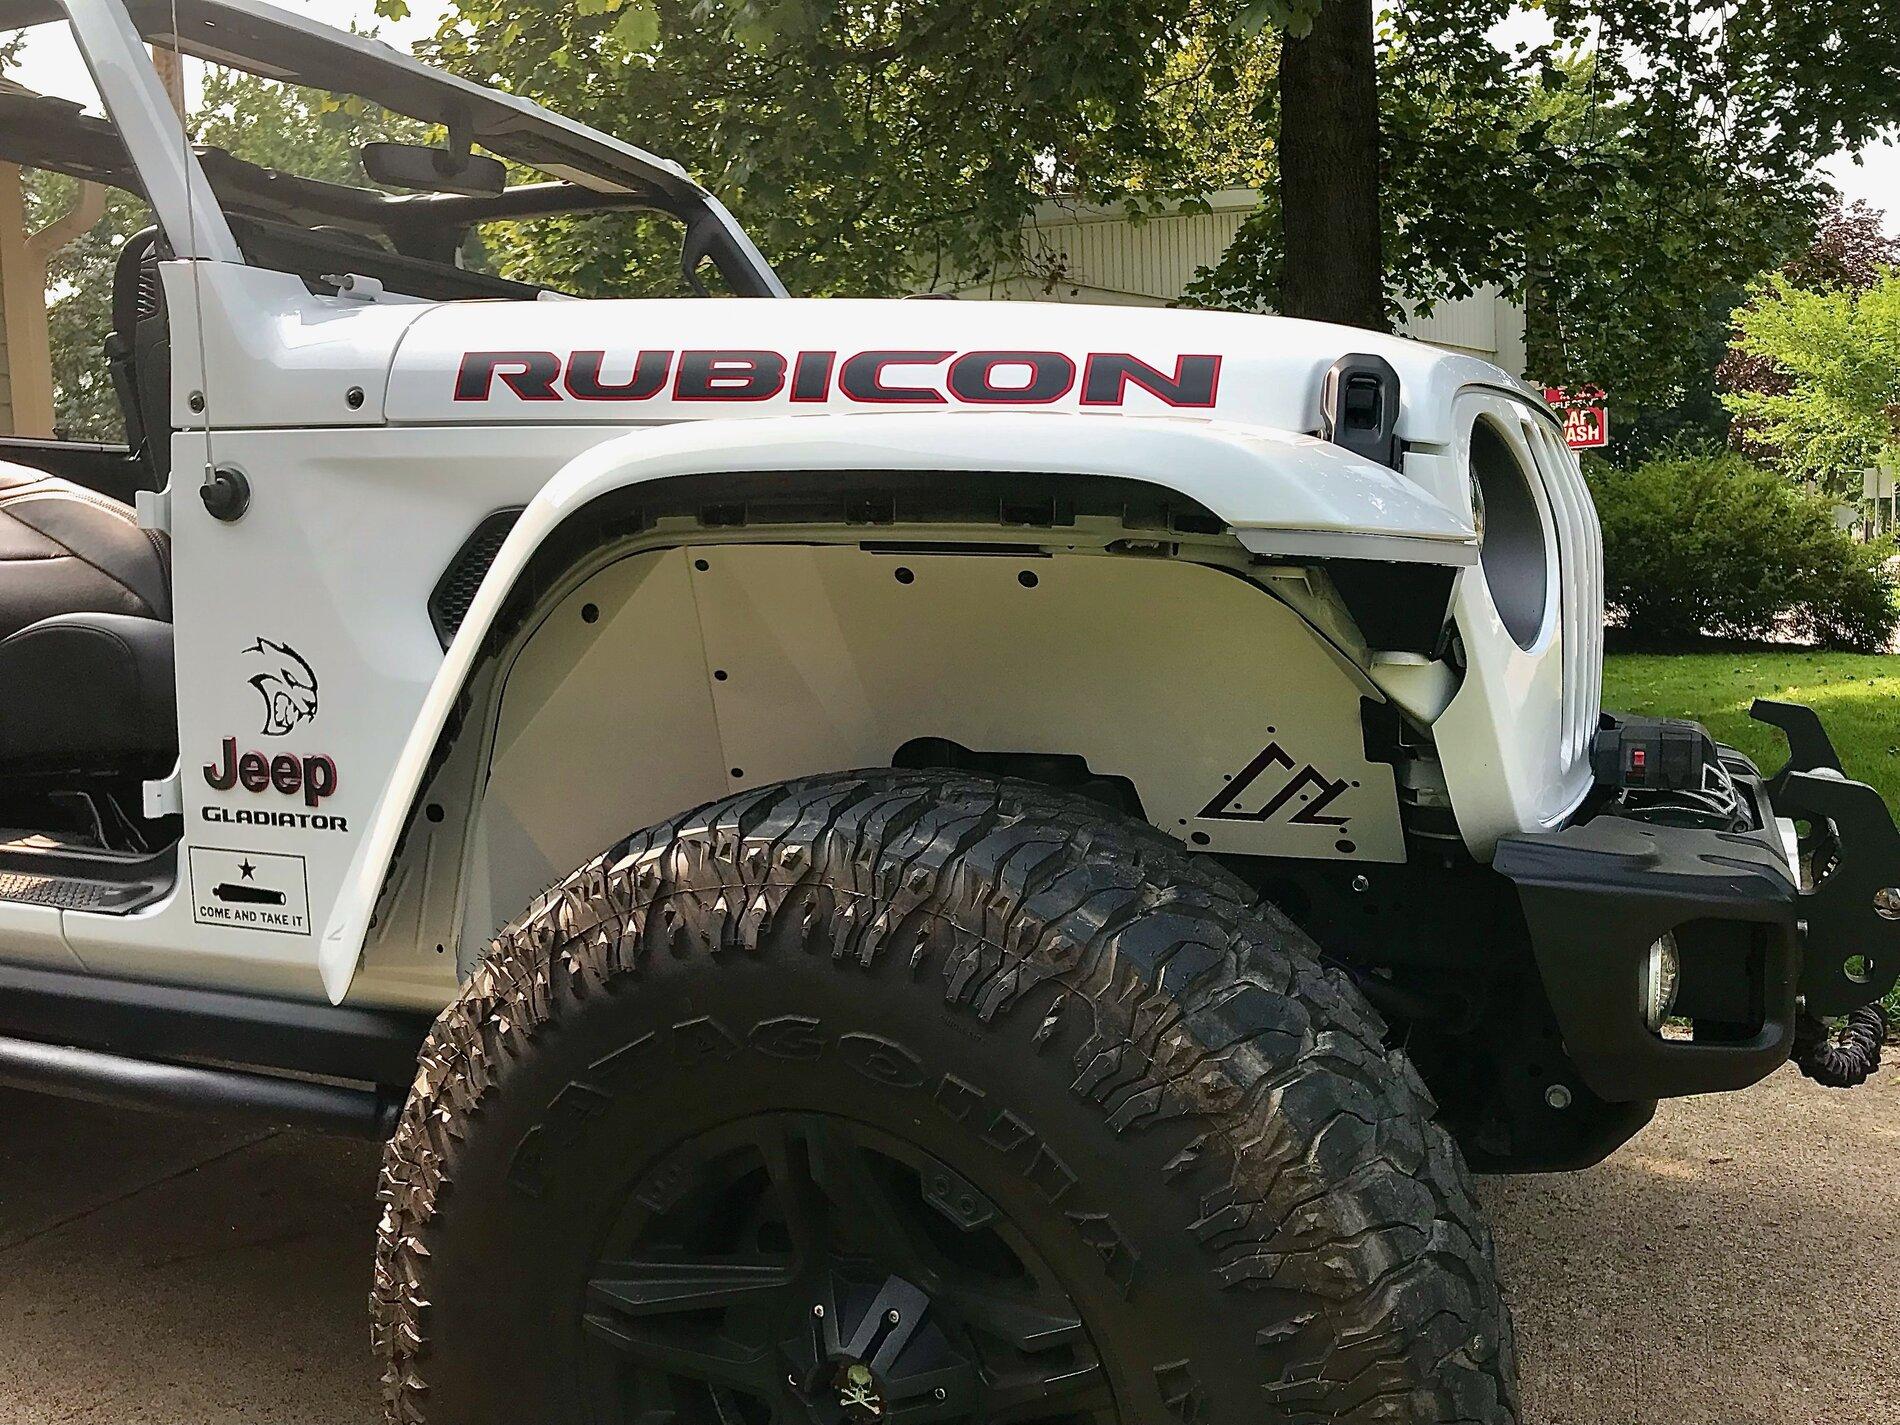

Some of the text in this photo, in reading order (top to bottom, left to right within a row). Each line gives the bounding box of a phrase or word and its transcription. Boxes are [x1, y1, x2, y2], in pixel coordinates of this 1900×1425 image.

[452, 350, 1223, 408] RUBICON
[1564, 425, 1600, 443] ASH
[202, 736, 338, 808] Jeep
[201, 806, 349, 832] GLADIATOR
[200, 906, 303, 927] COME AND TAKE IT
